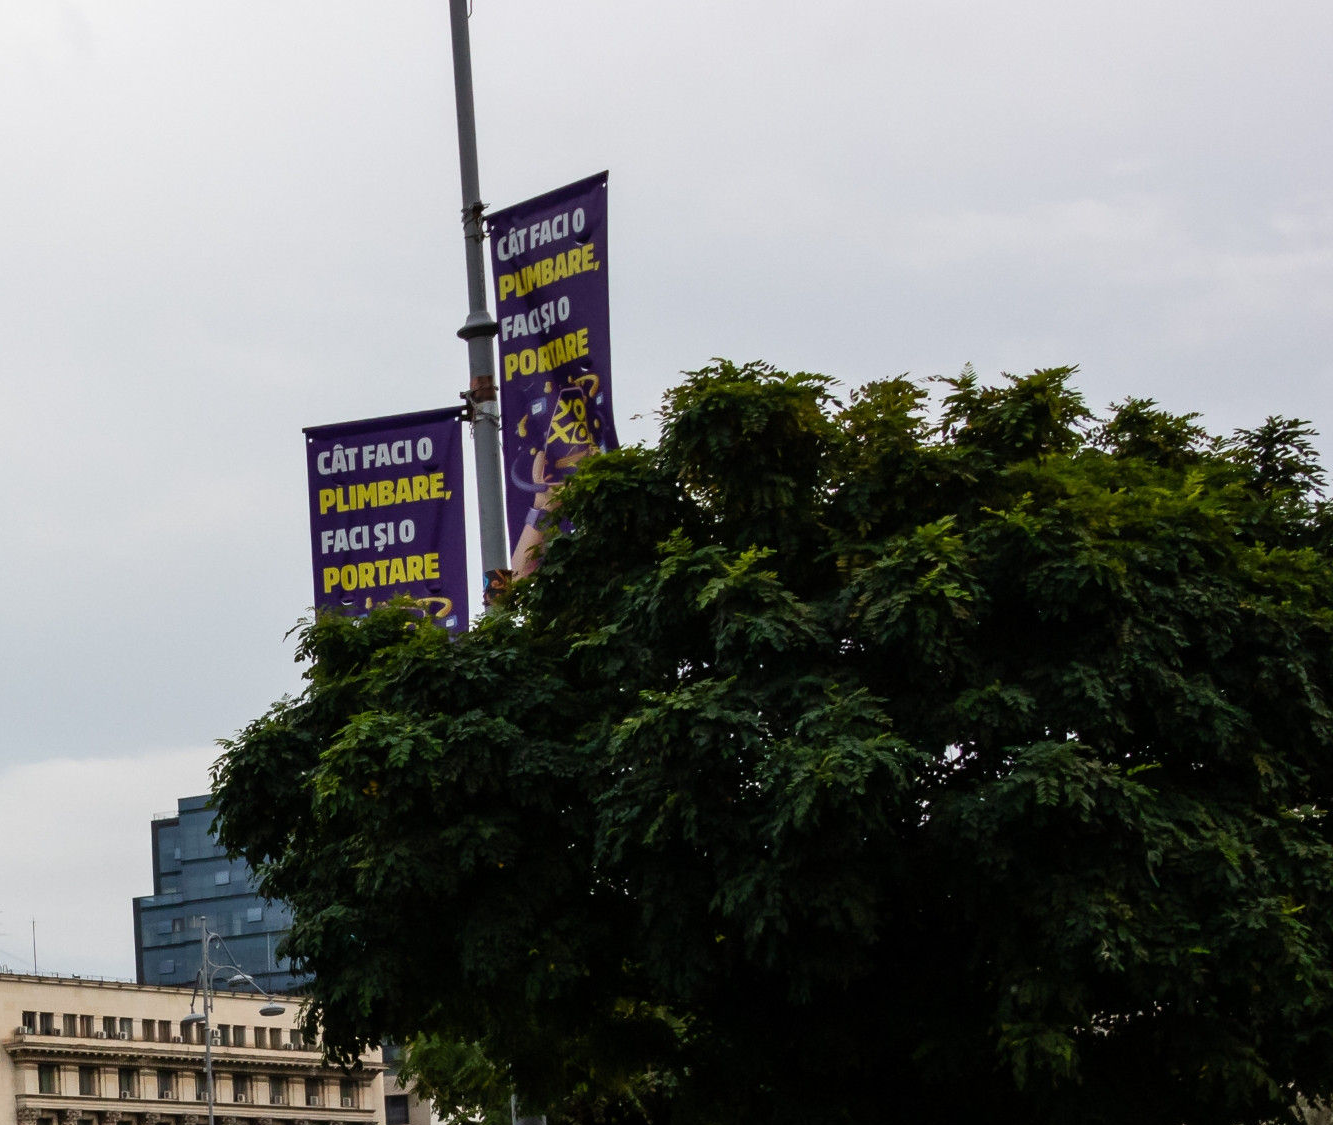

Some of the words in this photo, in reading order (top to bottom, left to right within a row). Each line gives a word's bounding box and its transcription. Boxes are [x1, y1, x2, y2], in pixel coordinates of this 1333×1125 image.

[497, 226, 528, 262] CÂT
[530, 212, 569, 250] FACI
[572, 207, 586, 233] O
[498, 243, 600, 301] PLIMBARE,
[501, 307, 541, 342] FACI
[541, 301, 554, 334] ȘI
[557, 295, 570, 322] O
[504, 327, 589, 382] PORTARE
[317, 444, 358, 475] CÂT
[362, 440, 413, 469] FACI
[417, 437, 433, 461] O
[319, 472, 452, 515] PLIMBARE,
[321, 525, 370, 554] FACI
[374, 522, 395, 553] ȘI
[399, 519, 415, 543] O
[323, 553, 440, 594] PORTARE
